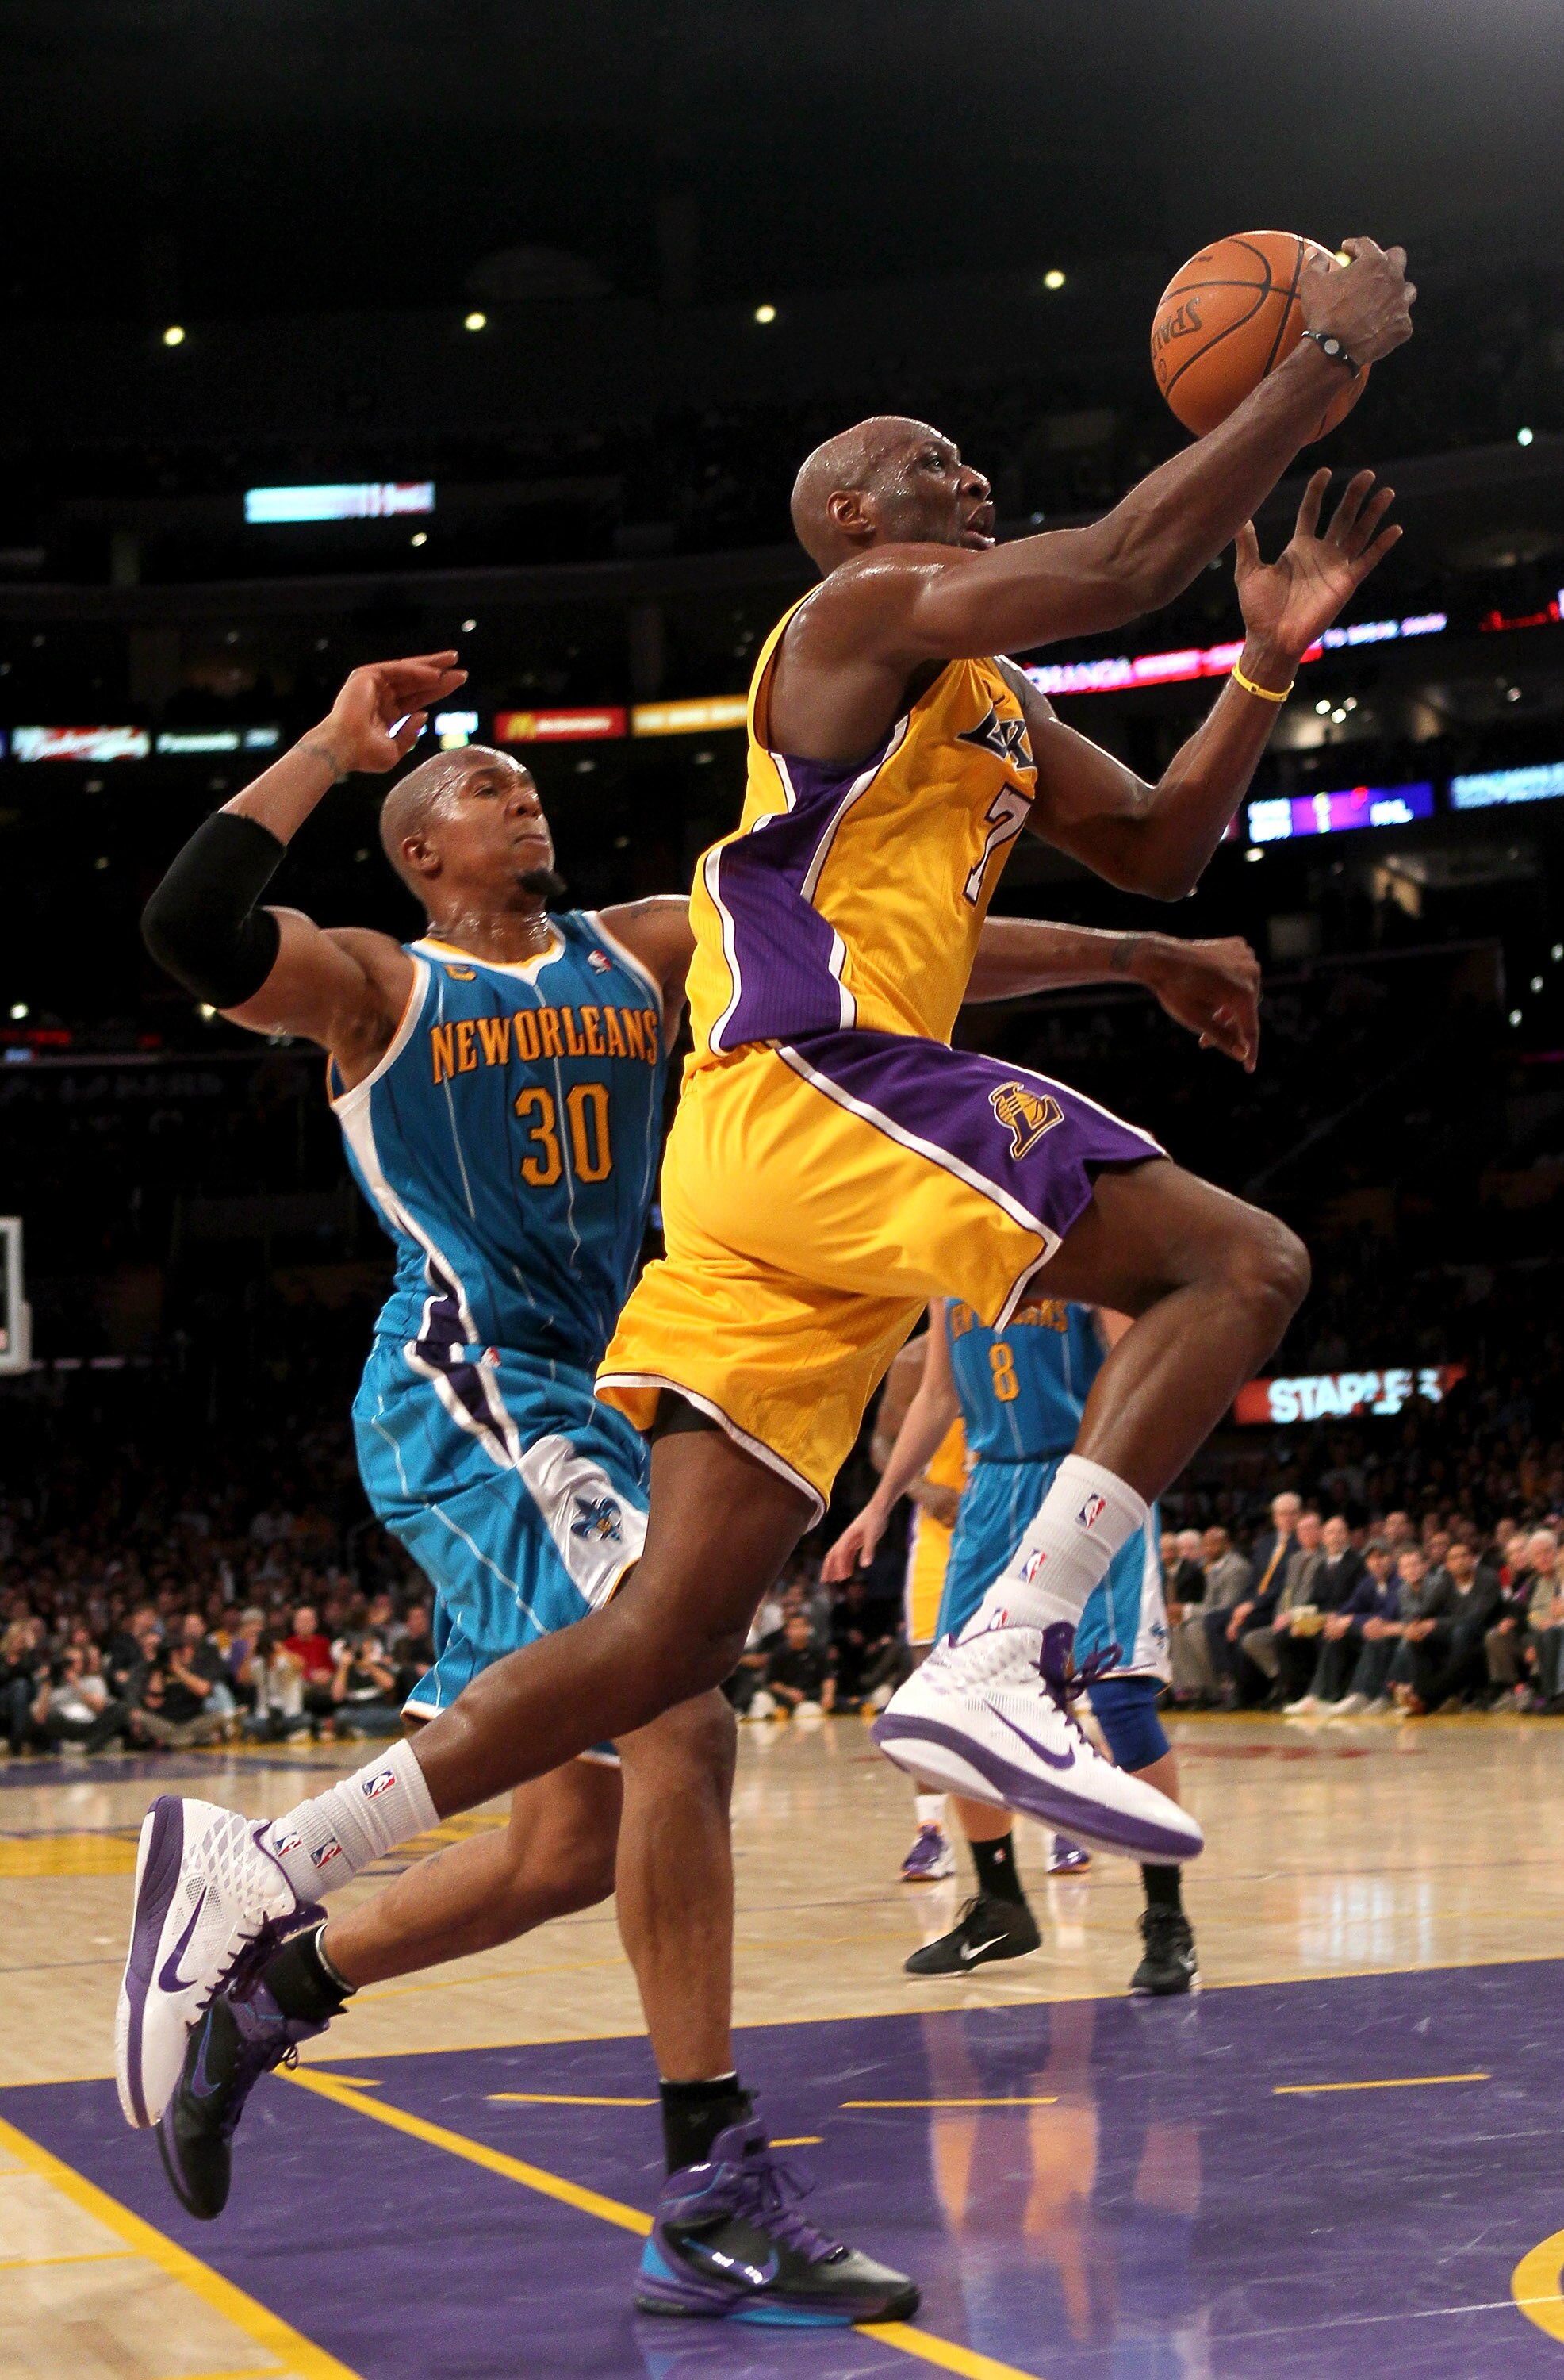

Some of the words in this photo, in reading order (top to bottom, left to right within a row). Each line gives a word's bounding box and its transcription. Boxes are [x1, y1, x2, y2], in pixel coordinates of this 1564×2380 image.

[961, 781, 1032, 908] 7
[430, 1016, 512, 1085] NEW
[512, 1004, 660, 1067] ORLEANS
[513, 1081, 613, 1187] 30
[988, 1342, 1020, 1403] 8
